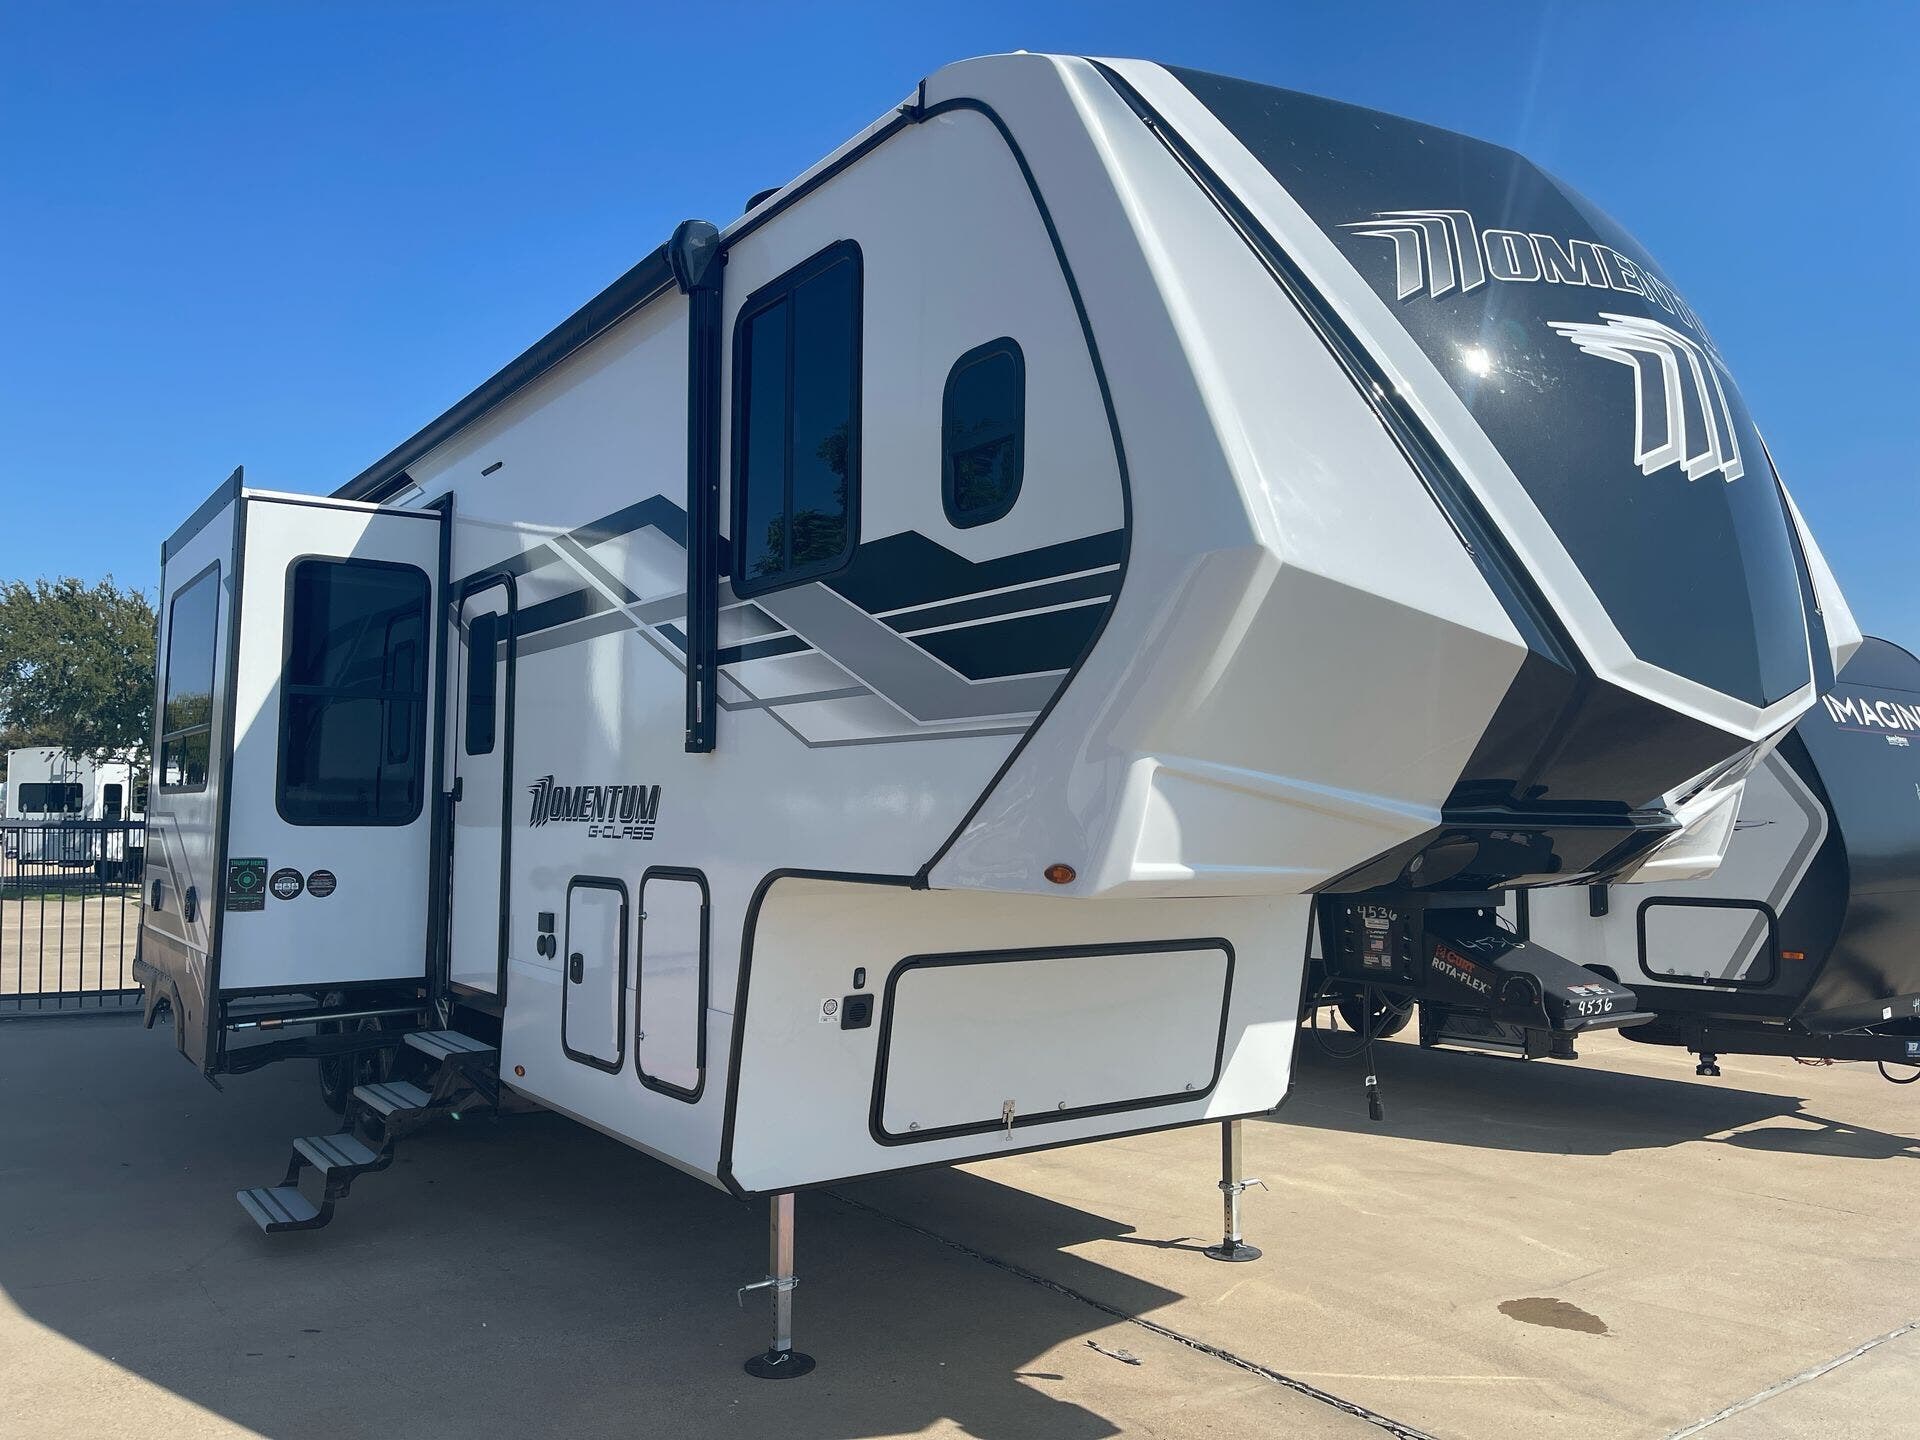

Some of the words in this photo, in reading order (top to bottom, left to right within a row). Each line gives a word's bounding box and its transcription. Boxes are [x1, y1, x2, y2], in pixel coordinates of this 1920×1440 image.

[527, 774, 661, 828] MOMENTUM
[588, 825, 655, 841] G-CLASS
[1357, 905, 1398, 921] 4536
[1578, 997, 1613, 1016] 4536
